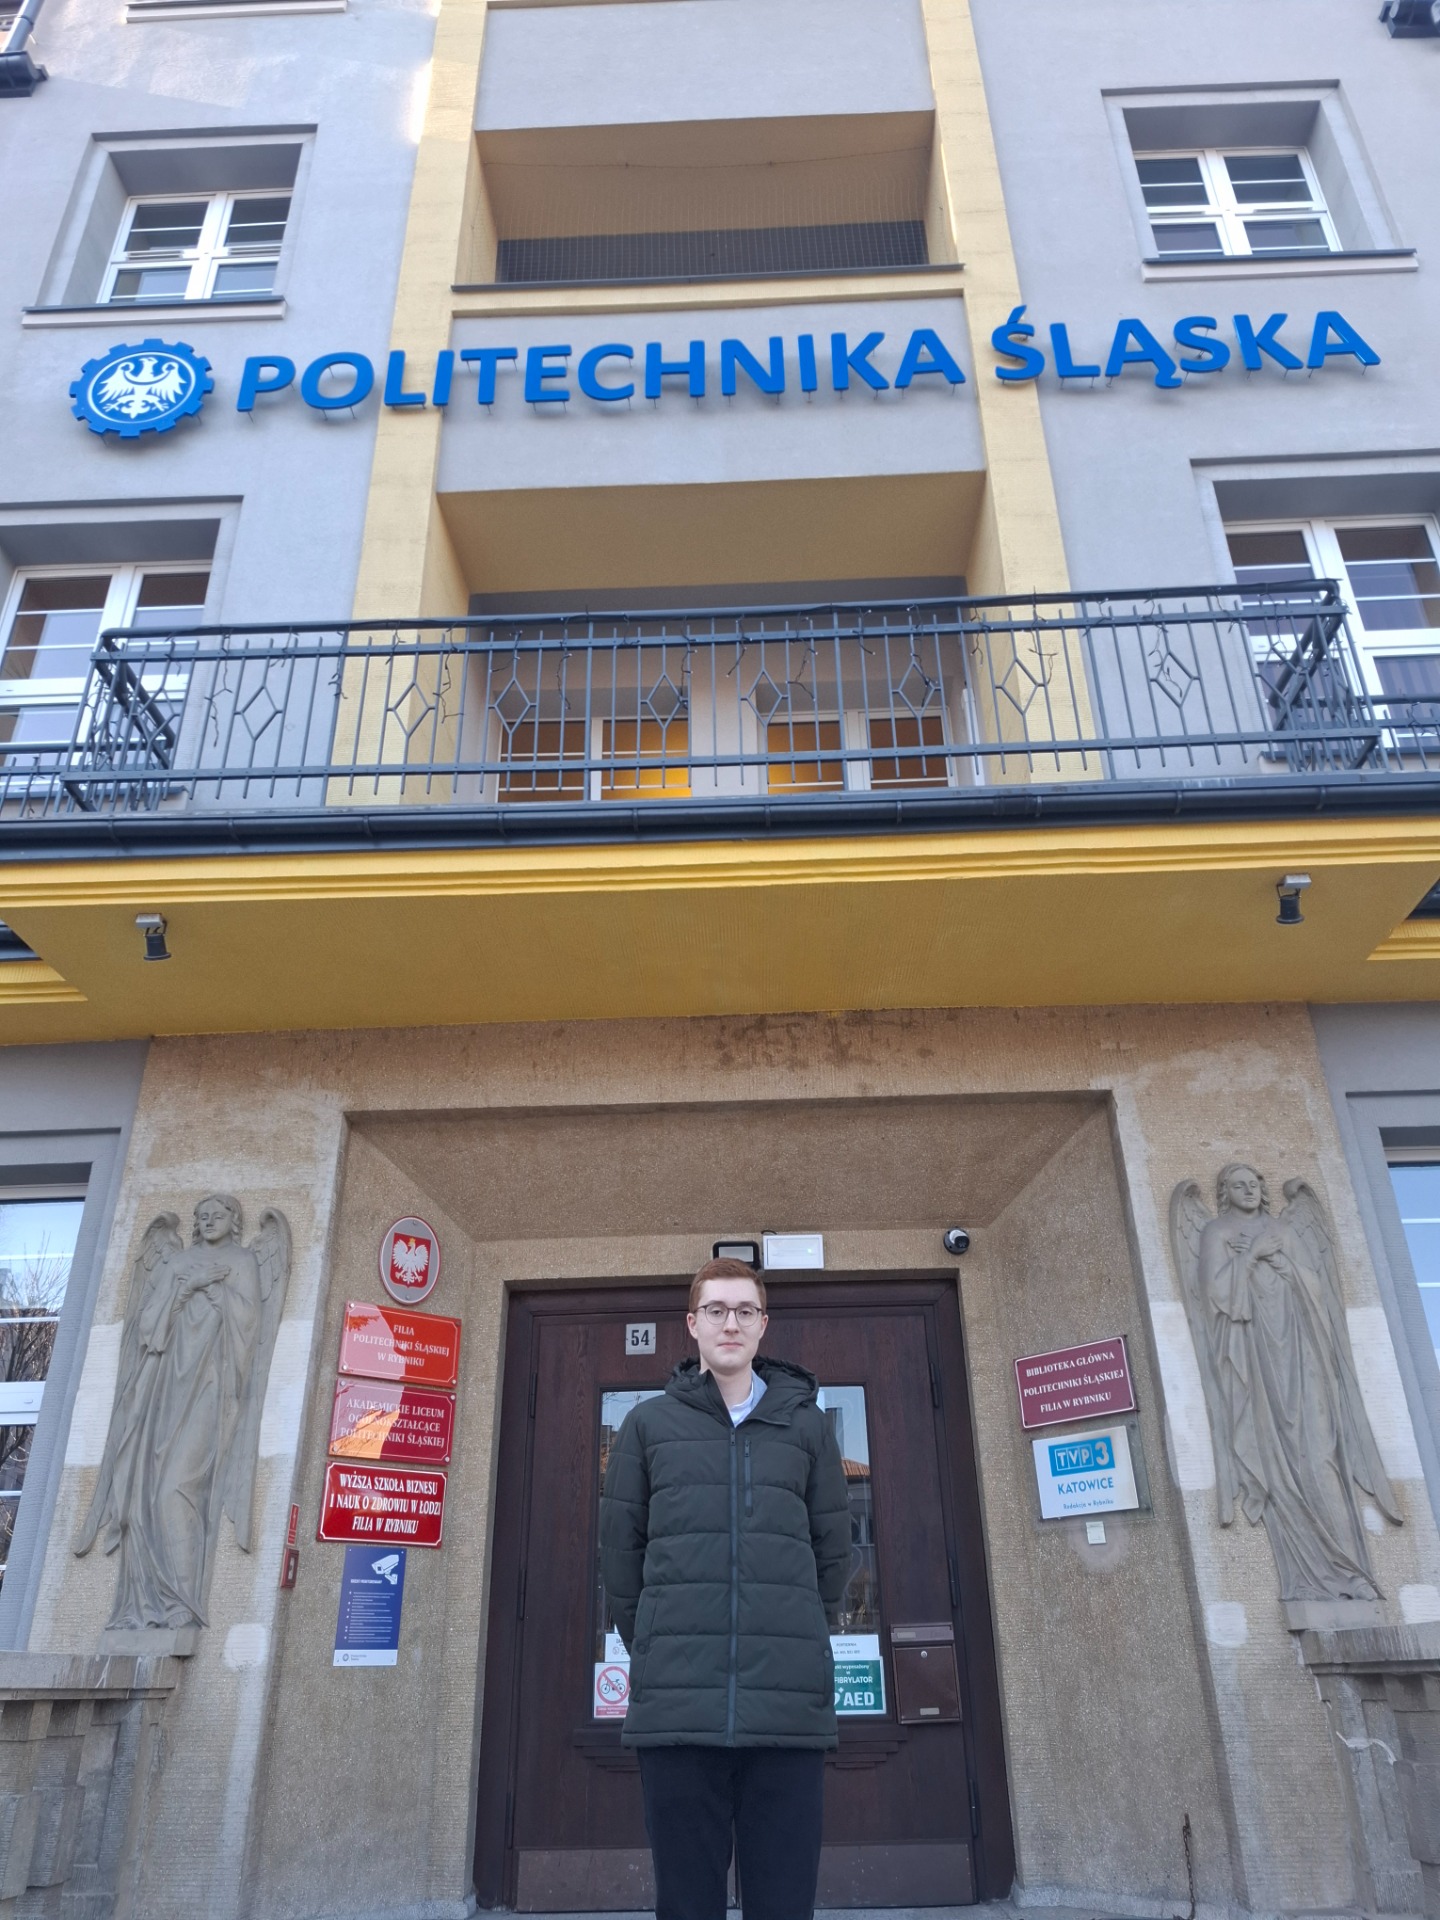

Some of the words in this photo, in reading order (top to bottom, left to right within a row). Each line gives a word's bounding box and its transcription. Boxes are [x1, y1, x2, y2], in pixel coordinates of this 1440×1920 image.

[237, 328, 966, 413] POLITECHNIKA
[990, 304, 1381, 389] ŚLĄSKA
[393, 1324, 415, 1336] FILIA
[630, 1329, 650, 1346] 54
[353, 1333, 413, 1351] POLITECHNIKI
[414, 1340, 450, 1357] ŚLĄSKIEJ
[377, 1352, 387, 1361] W
[387, 1354, 425, 1367] RYBNIKU
[1026, 1360, 1075, 1377] BIBLIOTEKA
[1076, 1351, 1115, 1367] GŁÓWNA
[1023, 1378, 1082, 1397] POLITECHNIKI
[1083, 1369, 1124, 1385] ŚLĄSKIEJ
[346, 1398, 410, 1414] AKADEMICKIE
[412, 1405, 445, 1418] LICEUM
[1040, 1400, 1062, 1413] FILIA
[1063, 1399, 1071, 1408] W
[1072, 1391, 1112, 1406] RYBNIKU
[340, 1427, 405, 1443] POLITECHNIKI
[407, 1432, 445, 1448] ŚLĄSKIEJ
[1057, 1448, 1090, 1467] TVP
[1094, 1441, 1110, 1466] 3
[339, 1470, 372, 1490] WYŻSZA
[374, 1476, 405, 1493] SZKOŁA
[406, 1479, 438, 1496] BIZNESU
[1057, 1477, 1114, 1495] KATOWICE
[329, 1493, 335, 1508] I
[336, 1494, 361, 1510] NAUK
[362, 1495, 370, 1510] O
[371, 1496, 409, 1513] ZDROWIU
[410, 1499, 418, 1514] W
[418, 1501, 442, 1516] ŁODZI
[1063, 1502, 1087, 1510] Redakcja
[1092, 1499, 1114, 1507] Rybniku
[352, 1516, 373, 1532] FILIA
[375, 1517, 384, 1531] W
[384, 1518, 420, 1534] RYBNIKU
[834, 1676, 873, 1684] FIBRYLATOR
[843, 1691, 875, 1706] AED
